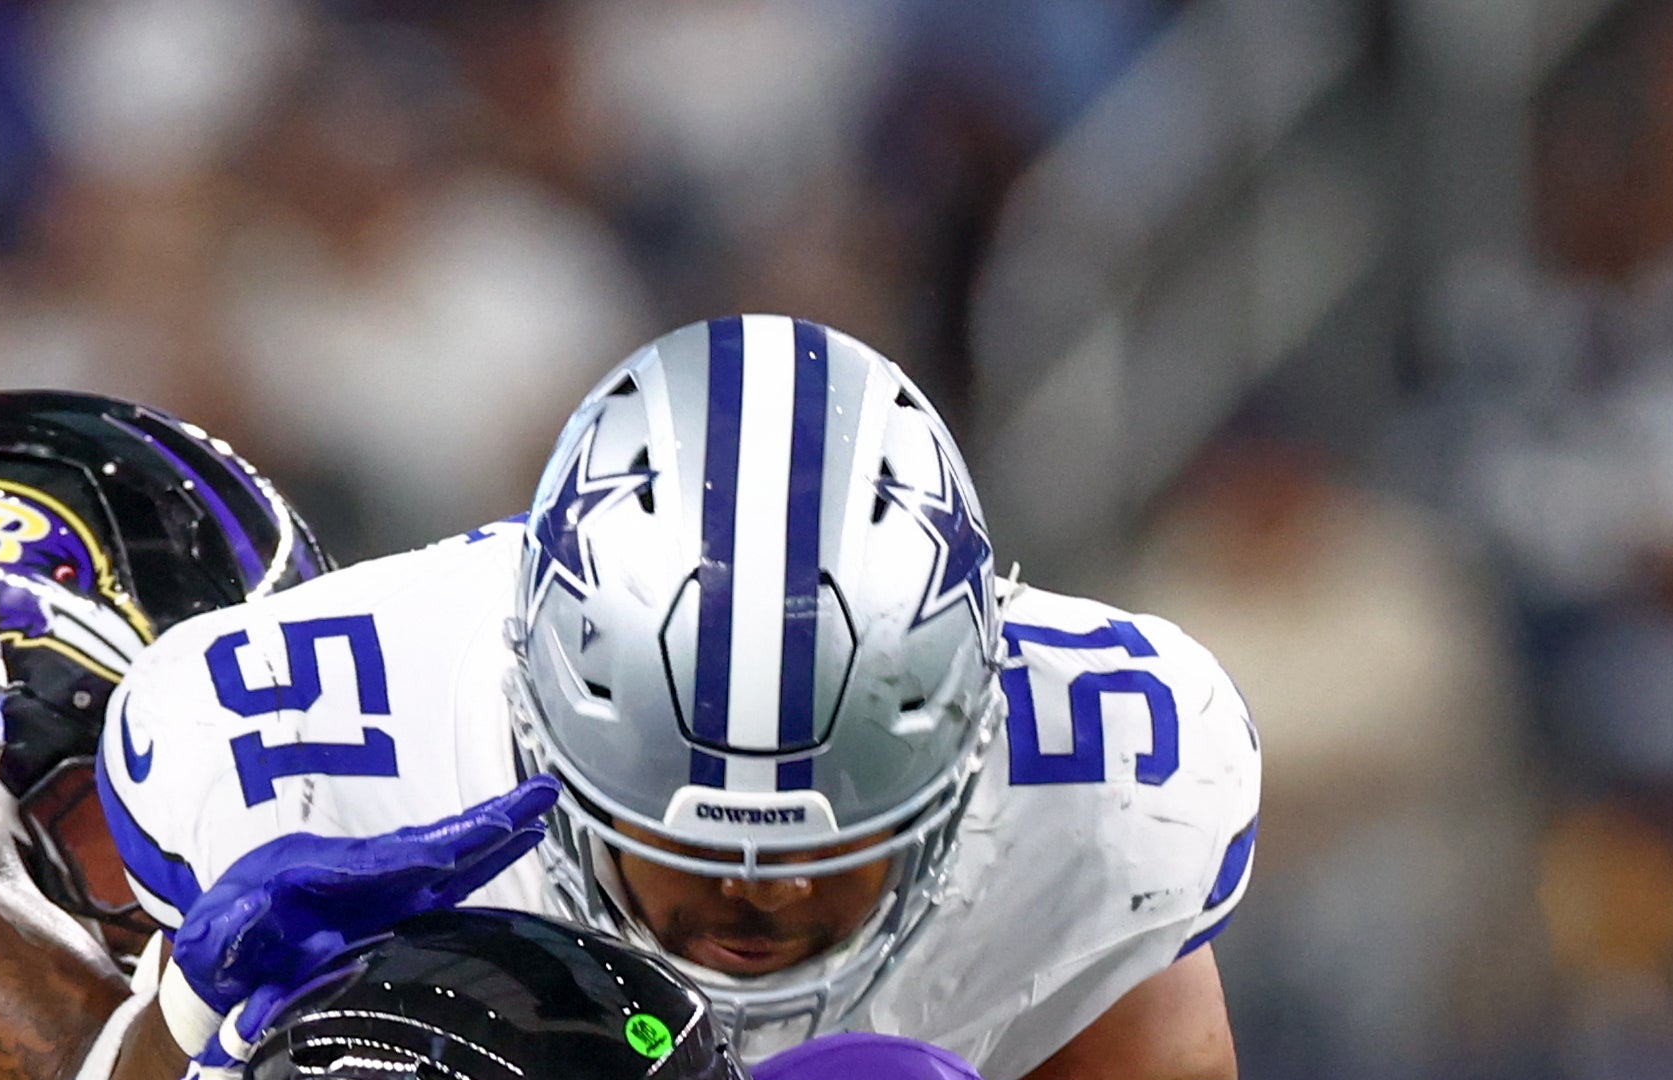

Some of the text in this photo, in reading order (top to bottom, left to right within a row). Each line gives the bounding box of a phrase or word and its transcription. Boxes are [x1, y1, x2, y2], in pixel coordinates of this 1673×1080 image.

[203, 612, 400, 809] 51
[998, 617, 1180, 787] 51
[696, 802, 806, 825] COWBOYS
